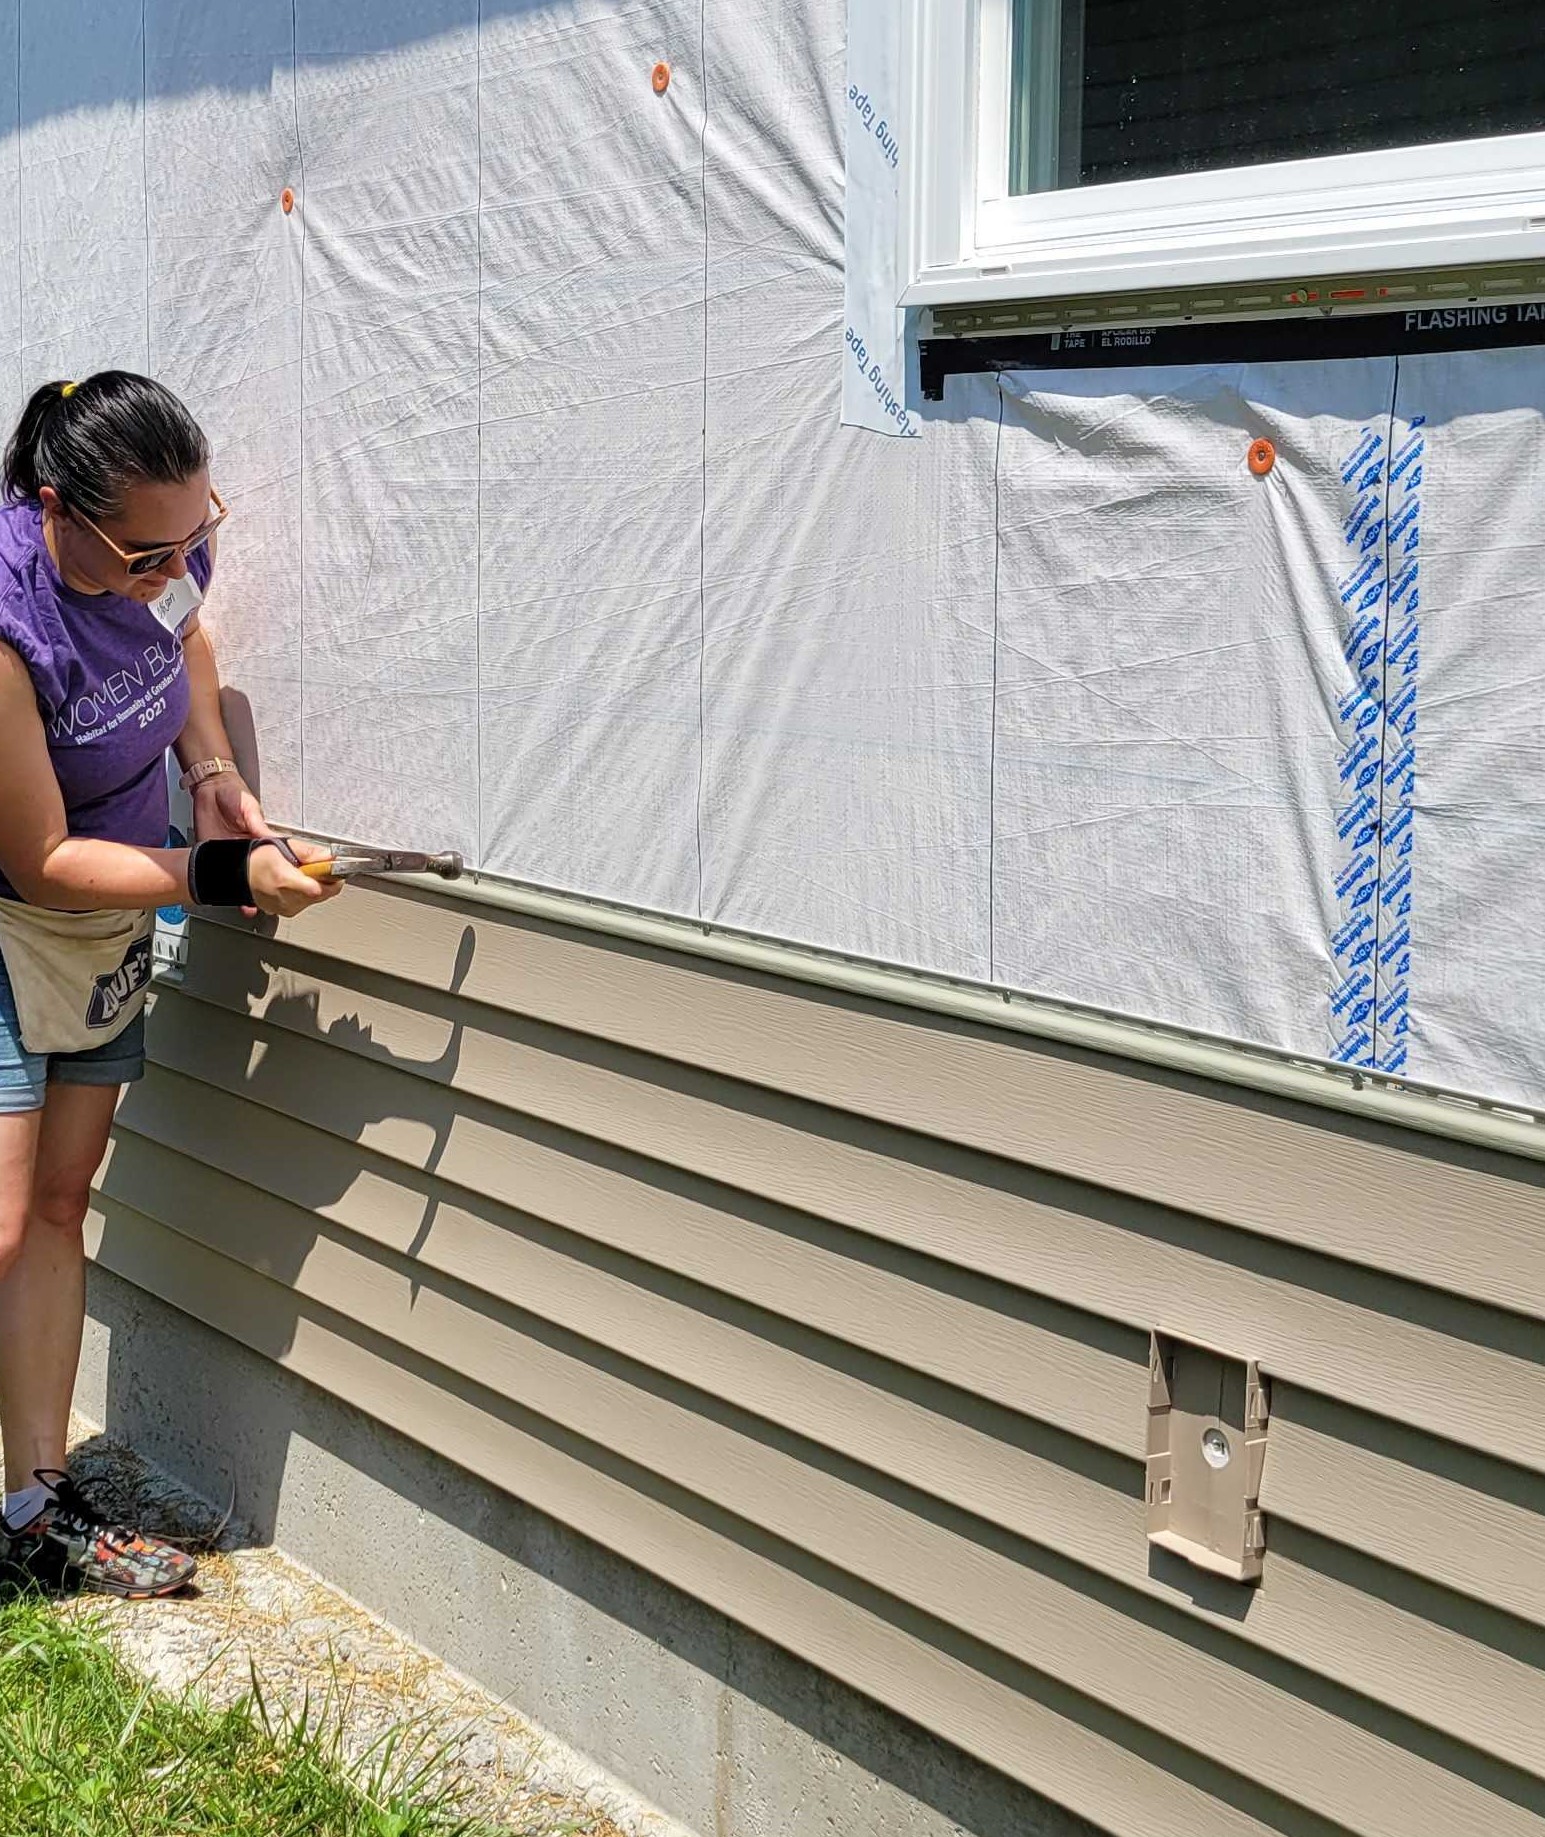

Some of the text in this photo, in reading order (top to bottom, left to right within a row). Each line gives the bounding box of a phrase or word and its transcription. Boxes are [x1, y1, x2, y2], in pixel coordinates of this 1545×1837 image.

[848, 84, 876, 132] Tape
[1405, 306, 1507, 331] FLASHING
[1064, 335, 1152, 348] TAPE EL RODILLO
[844, 326, 917, 436] lashing Tape
[1361, 463, 1380, 487] DOW
[1388, 440, 1424, 485] athermate
[1362, 525, 1379, 547] DOW
[1389, 501, 1420, 547] athermate
[1360, 585, 1381, 608] DOW
[1389, 562, 1419, 606] athermate
[1386, 624, 1419, 666] athermate
[51, 660, 144, 739] WOMEN
[74, 724, 108, 745] Habitat
[106, 718, 119, 731] for
[115, 697, 146, 724] Humanity
[144, 689, 154, 702] of
[151, 673, 174, 696] Greater
[137, 696, 167, 729] 2021
[1358, 764, 1377, 787] DOW
[1354, 883, 1373, 904] DOW
